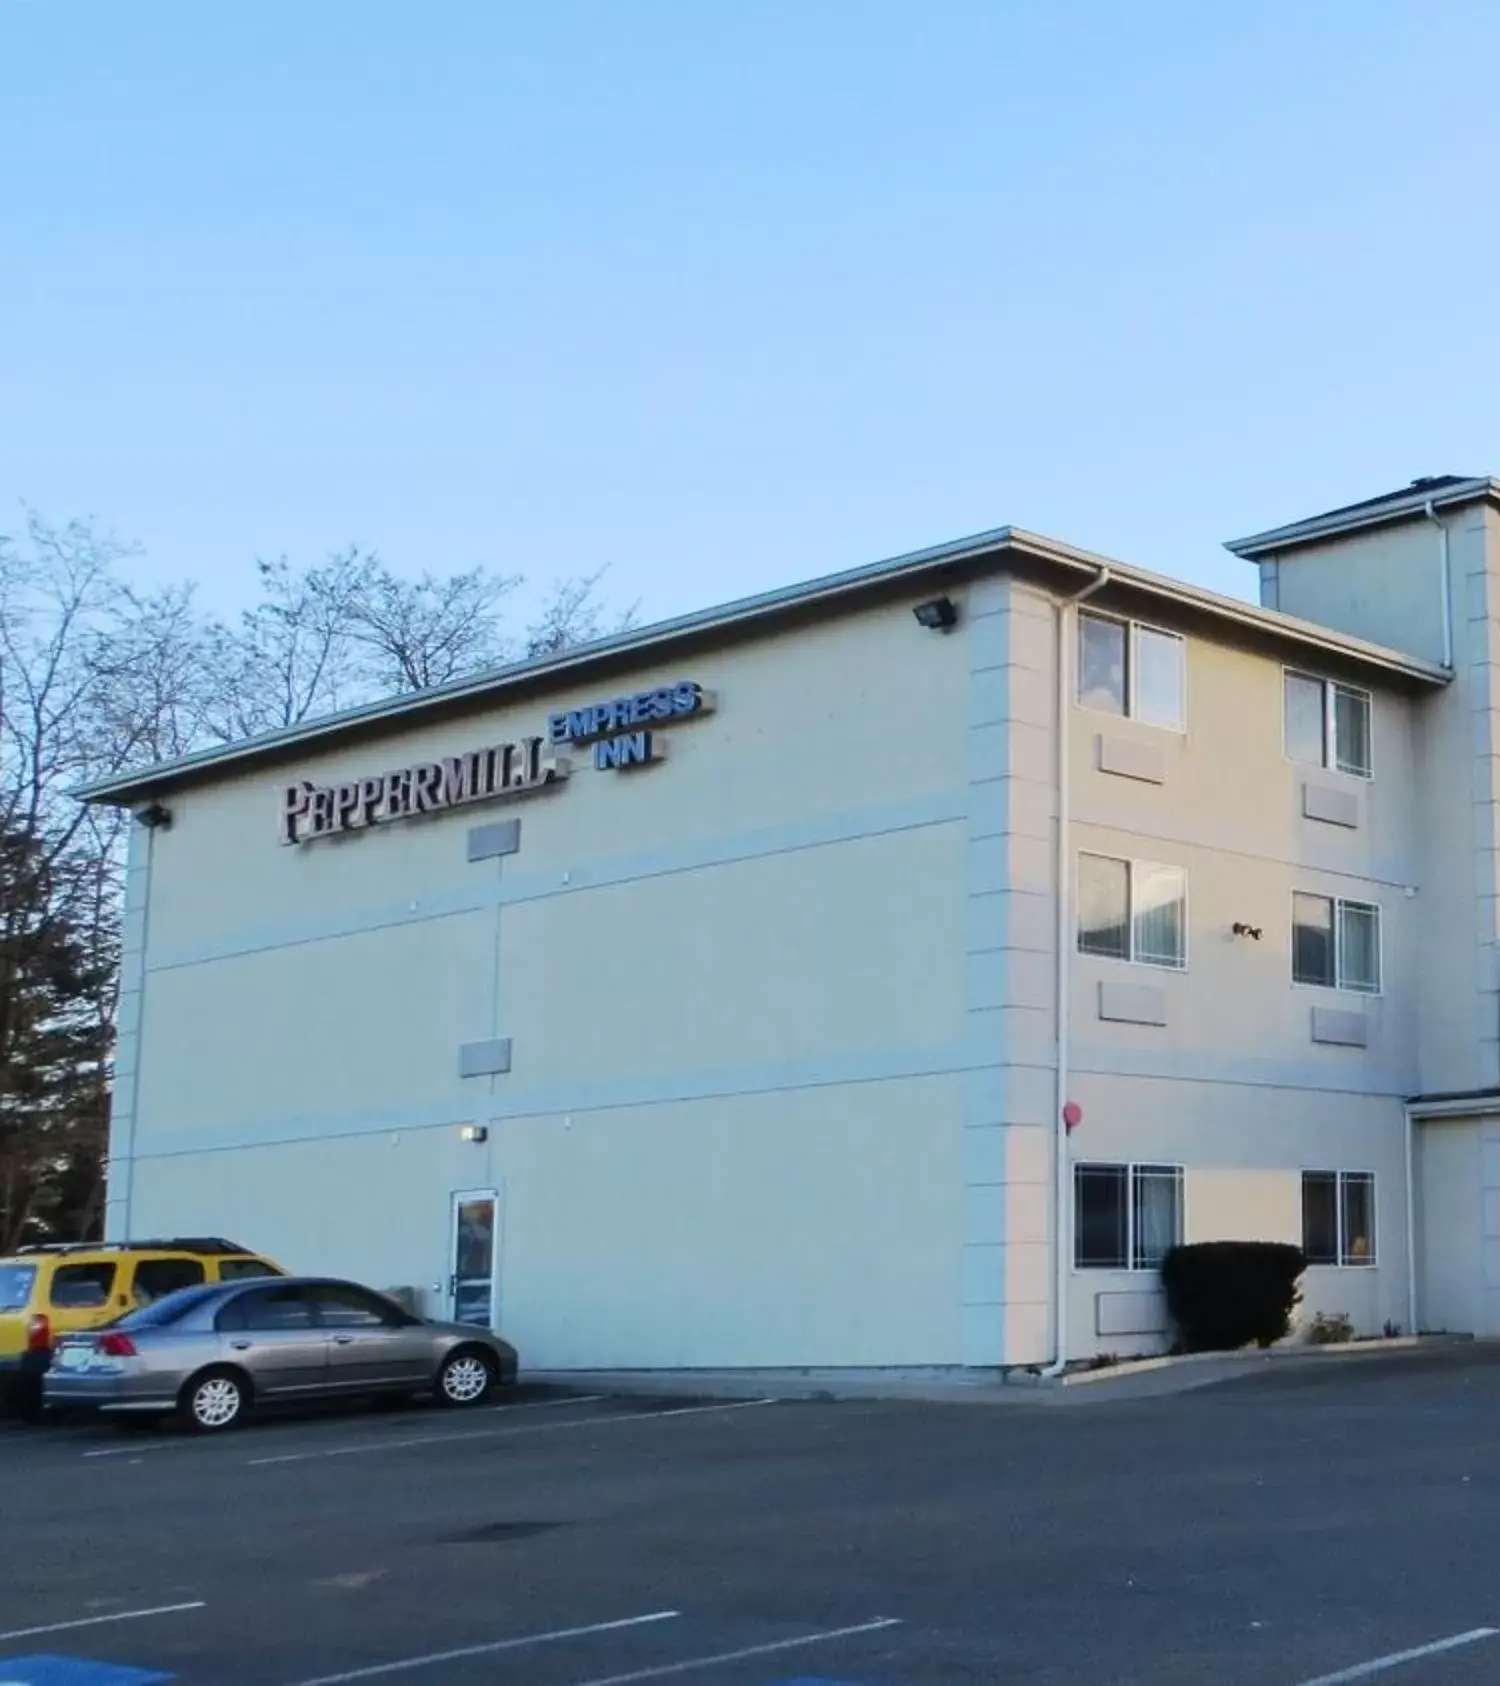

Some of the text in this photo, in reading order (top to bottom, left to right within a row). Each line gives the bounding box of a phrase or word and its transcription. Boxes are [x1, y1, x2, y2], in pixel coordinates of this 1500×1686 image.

[548, 680, 703, 745] EMPRESS
[594, 731, 652, 770] INN
[281, 736, 556, 846] PEPPERMILL
